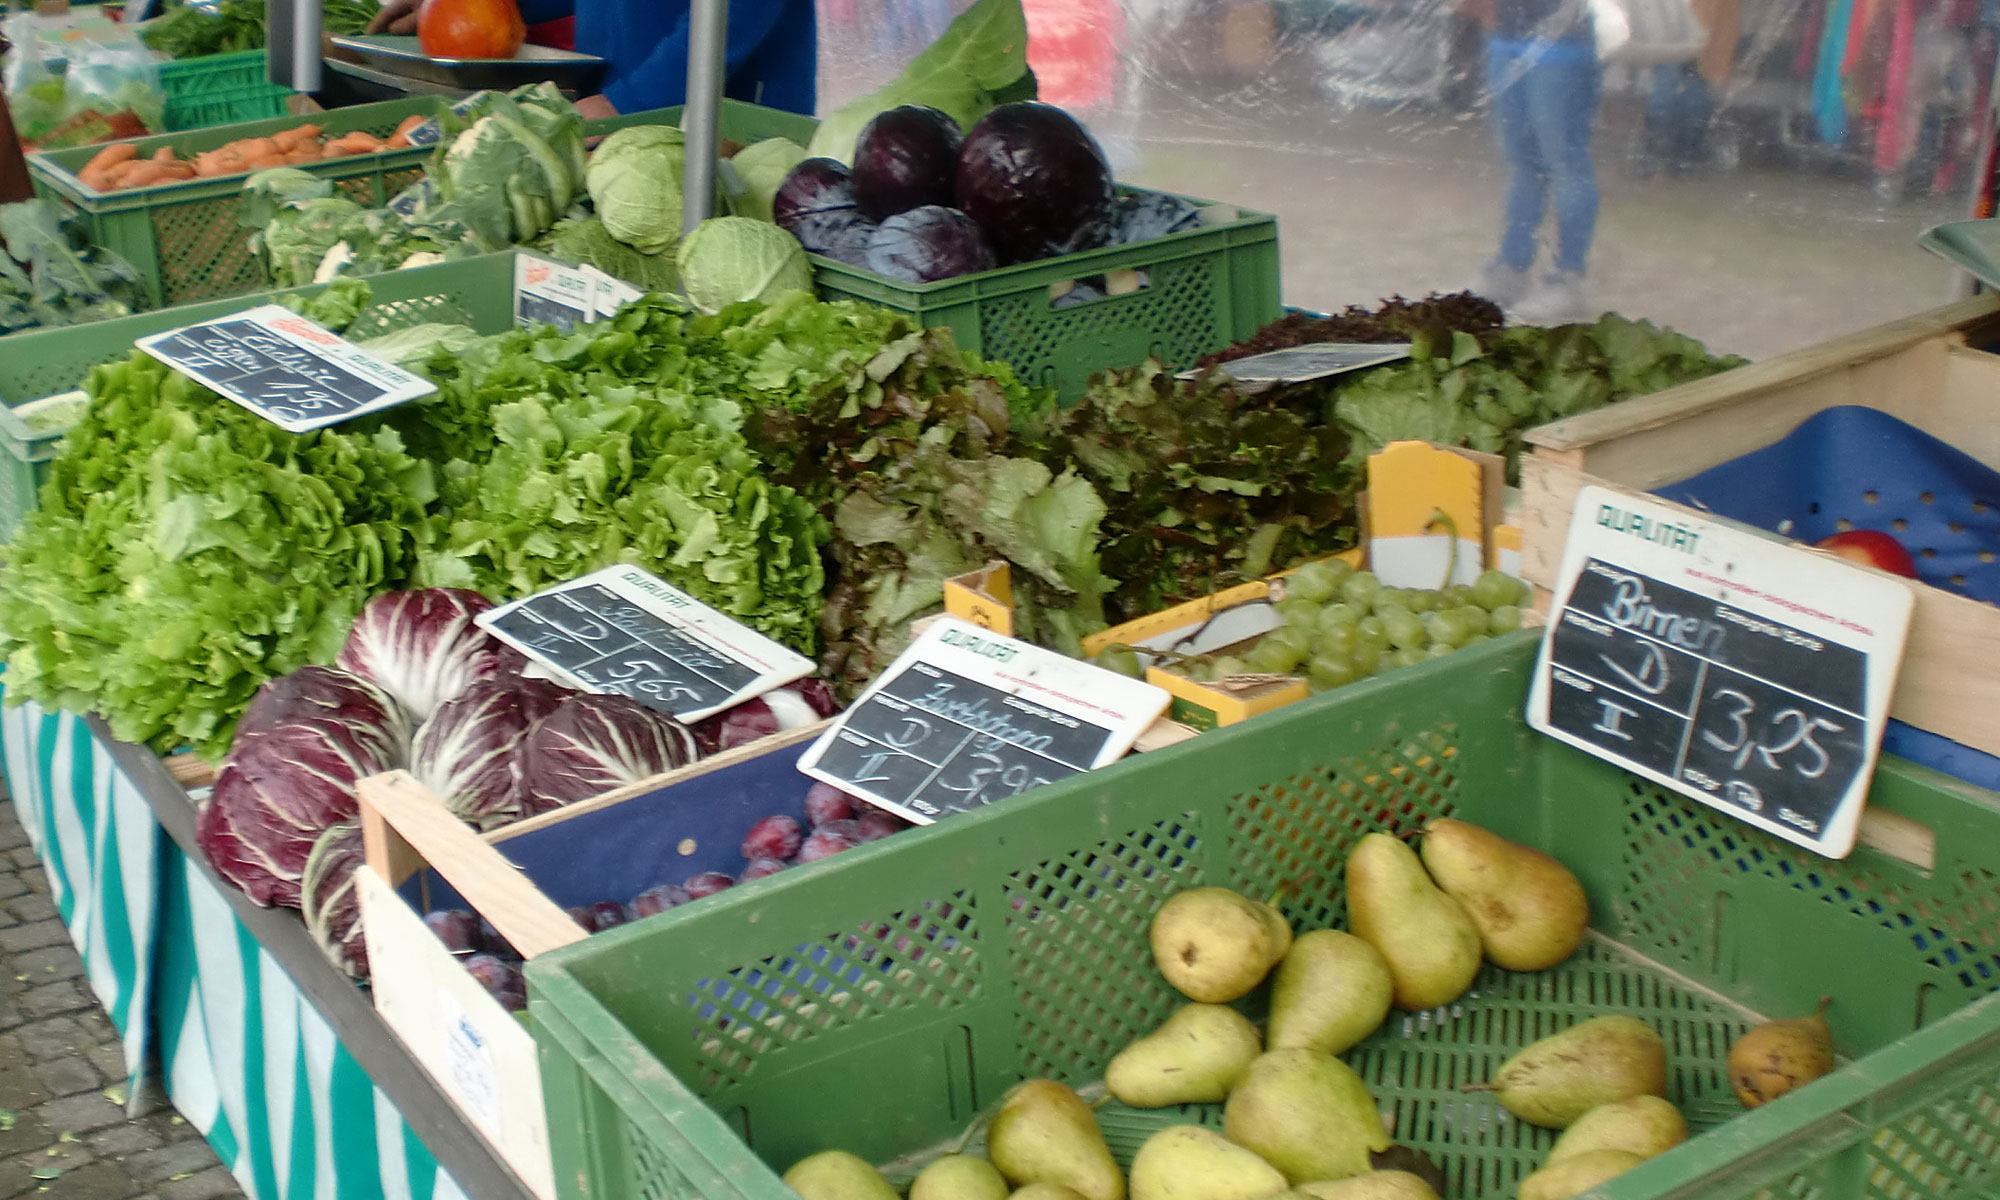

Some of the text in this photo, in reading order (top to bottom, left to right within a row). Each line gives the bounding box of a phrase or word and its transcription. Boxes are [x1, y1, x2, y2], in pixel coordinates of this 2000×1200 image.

[347, 354, 411, 384] QUALITÄT
[259, 382, 345, 410] 1,95
[1597, 504, 1700, 554] QUALITÄT
[621, 572, 690, 609] QUALITÄT
[550, 616, 610, 641] D
[1603, 575, 1727, 655] Birnen
[521, 631, 576, 654] II
[939, 628, 1019, 663] QUALITÄT
[607, 660, 704, 702] 5,65
[1599, 639, 1669, 694] D
[884, 717, 933, 748] D
[1702, 689, 1846, 779] 3,25
